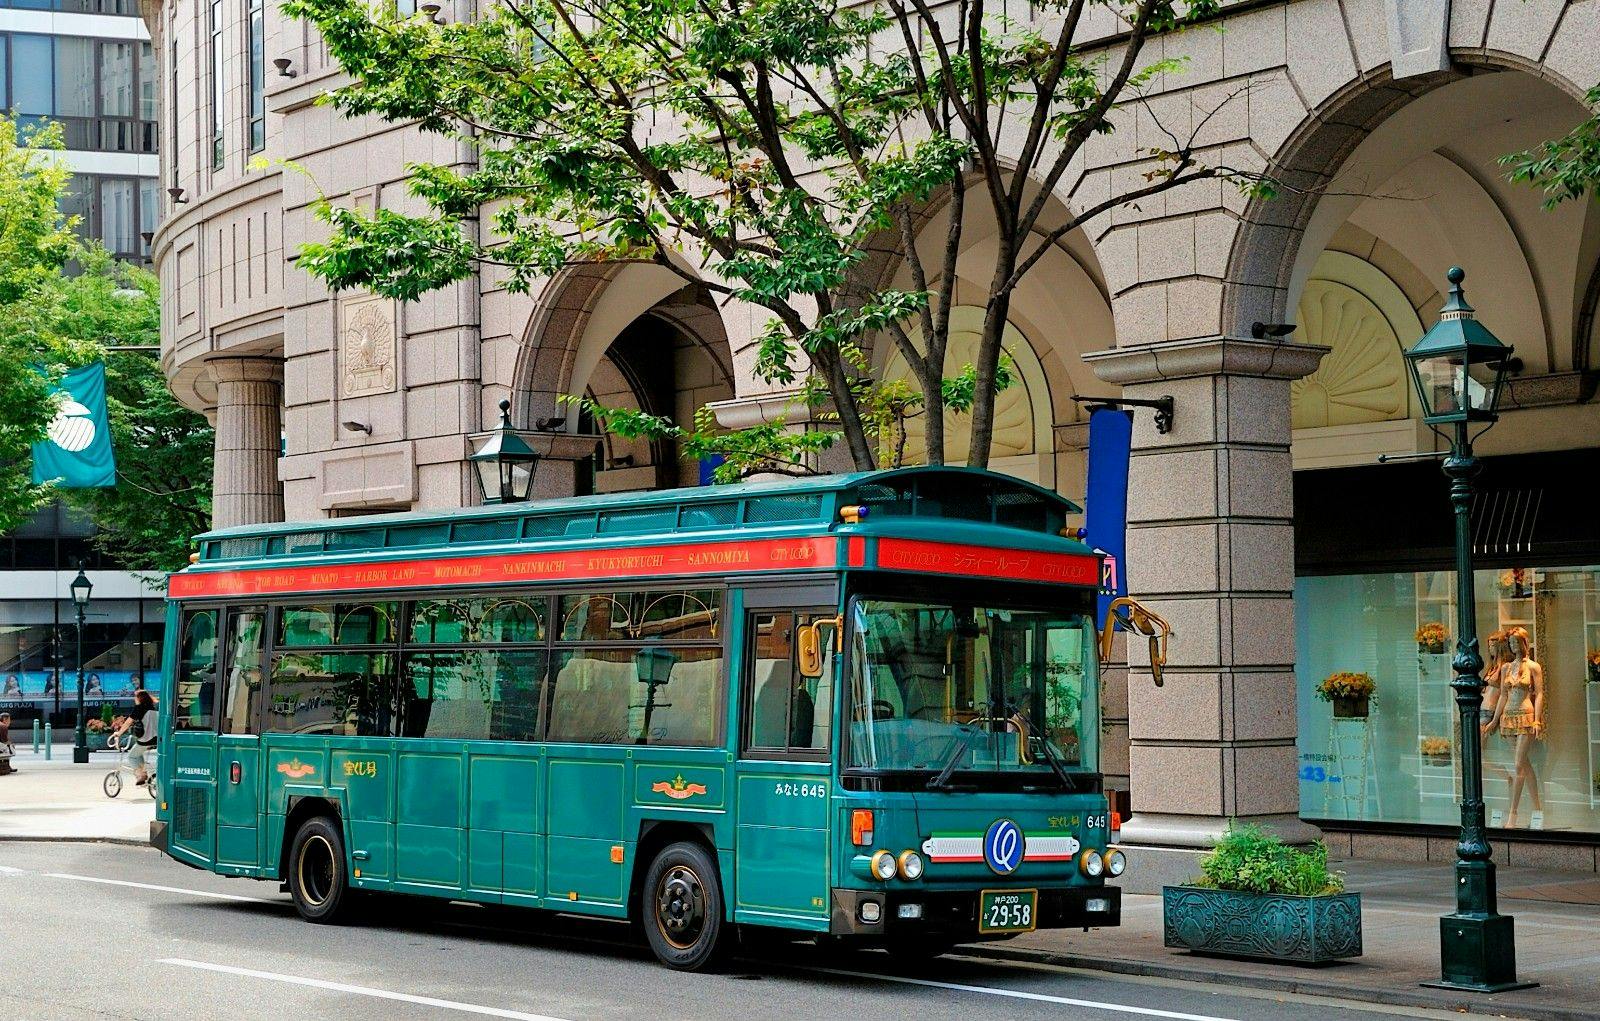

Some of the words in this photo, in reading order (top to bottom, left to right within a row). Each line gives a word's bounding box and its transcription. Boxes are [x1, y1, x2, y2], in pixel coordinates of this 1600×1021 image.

[274, 575, 296, 586] ROAD
[311, 573, 339, 584] MINATO
[355, 570, 388, 583] HARBOR
[392, 568, 415, 580] LAND
[434, 564, 482, 578] MOTOMACHI
[502, 560, 566, 575] NANKINMACHI
[587, 554, 664, 571] KYUKYORYUCHI
[687, 549, 751, 566] SANNOMIYA
[1087, 815, 1106, 829] 645
